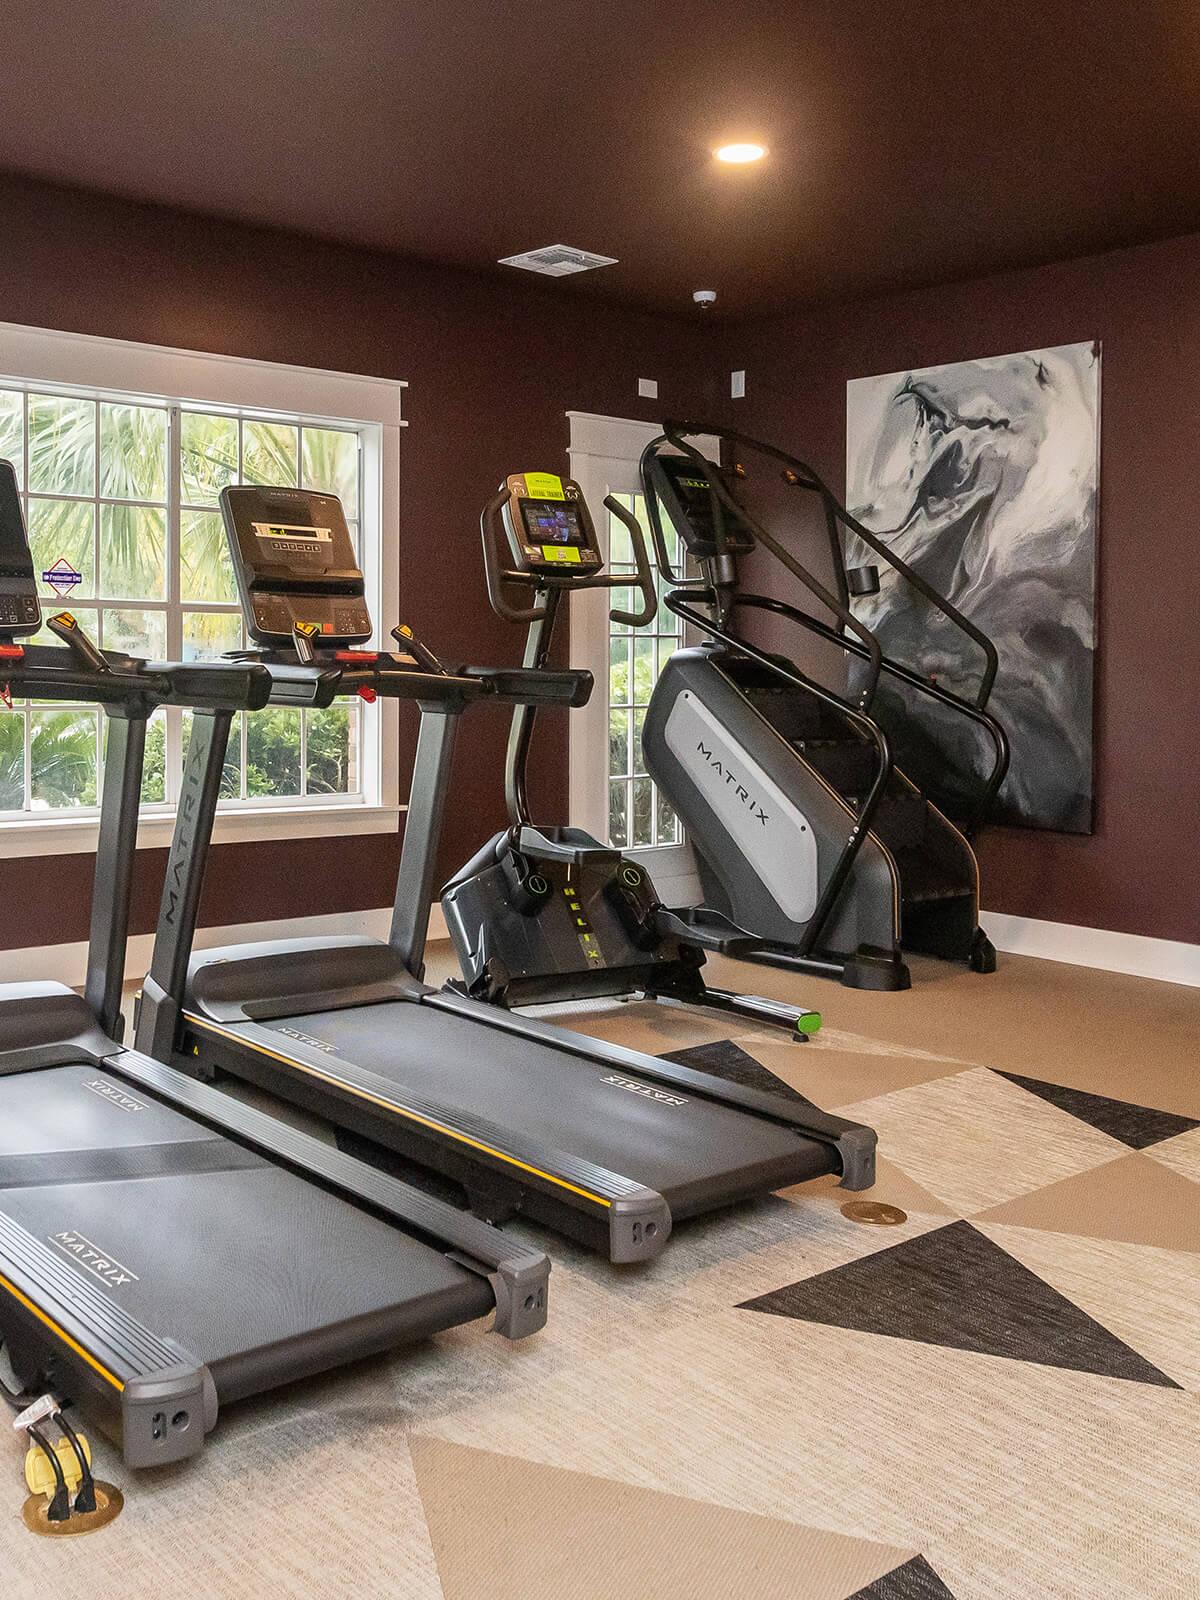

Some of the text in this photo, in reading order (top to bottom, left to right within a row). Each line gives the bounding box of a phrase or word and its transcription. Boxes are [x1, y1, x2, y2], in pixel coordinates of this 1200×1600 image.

[696, 741, 770, 826] MATRIX
[165, 740, 206, 925] MATRIX
[563, 887, 599, 958] HELIX
[277, 1027, 335, 1053] MATRIX
[88, 1080, 144, 1112] MATRIX
[604, 1075, 685, 1106] MATRIX
[55, 1231, 131, 1286] MATRIX
